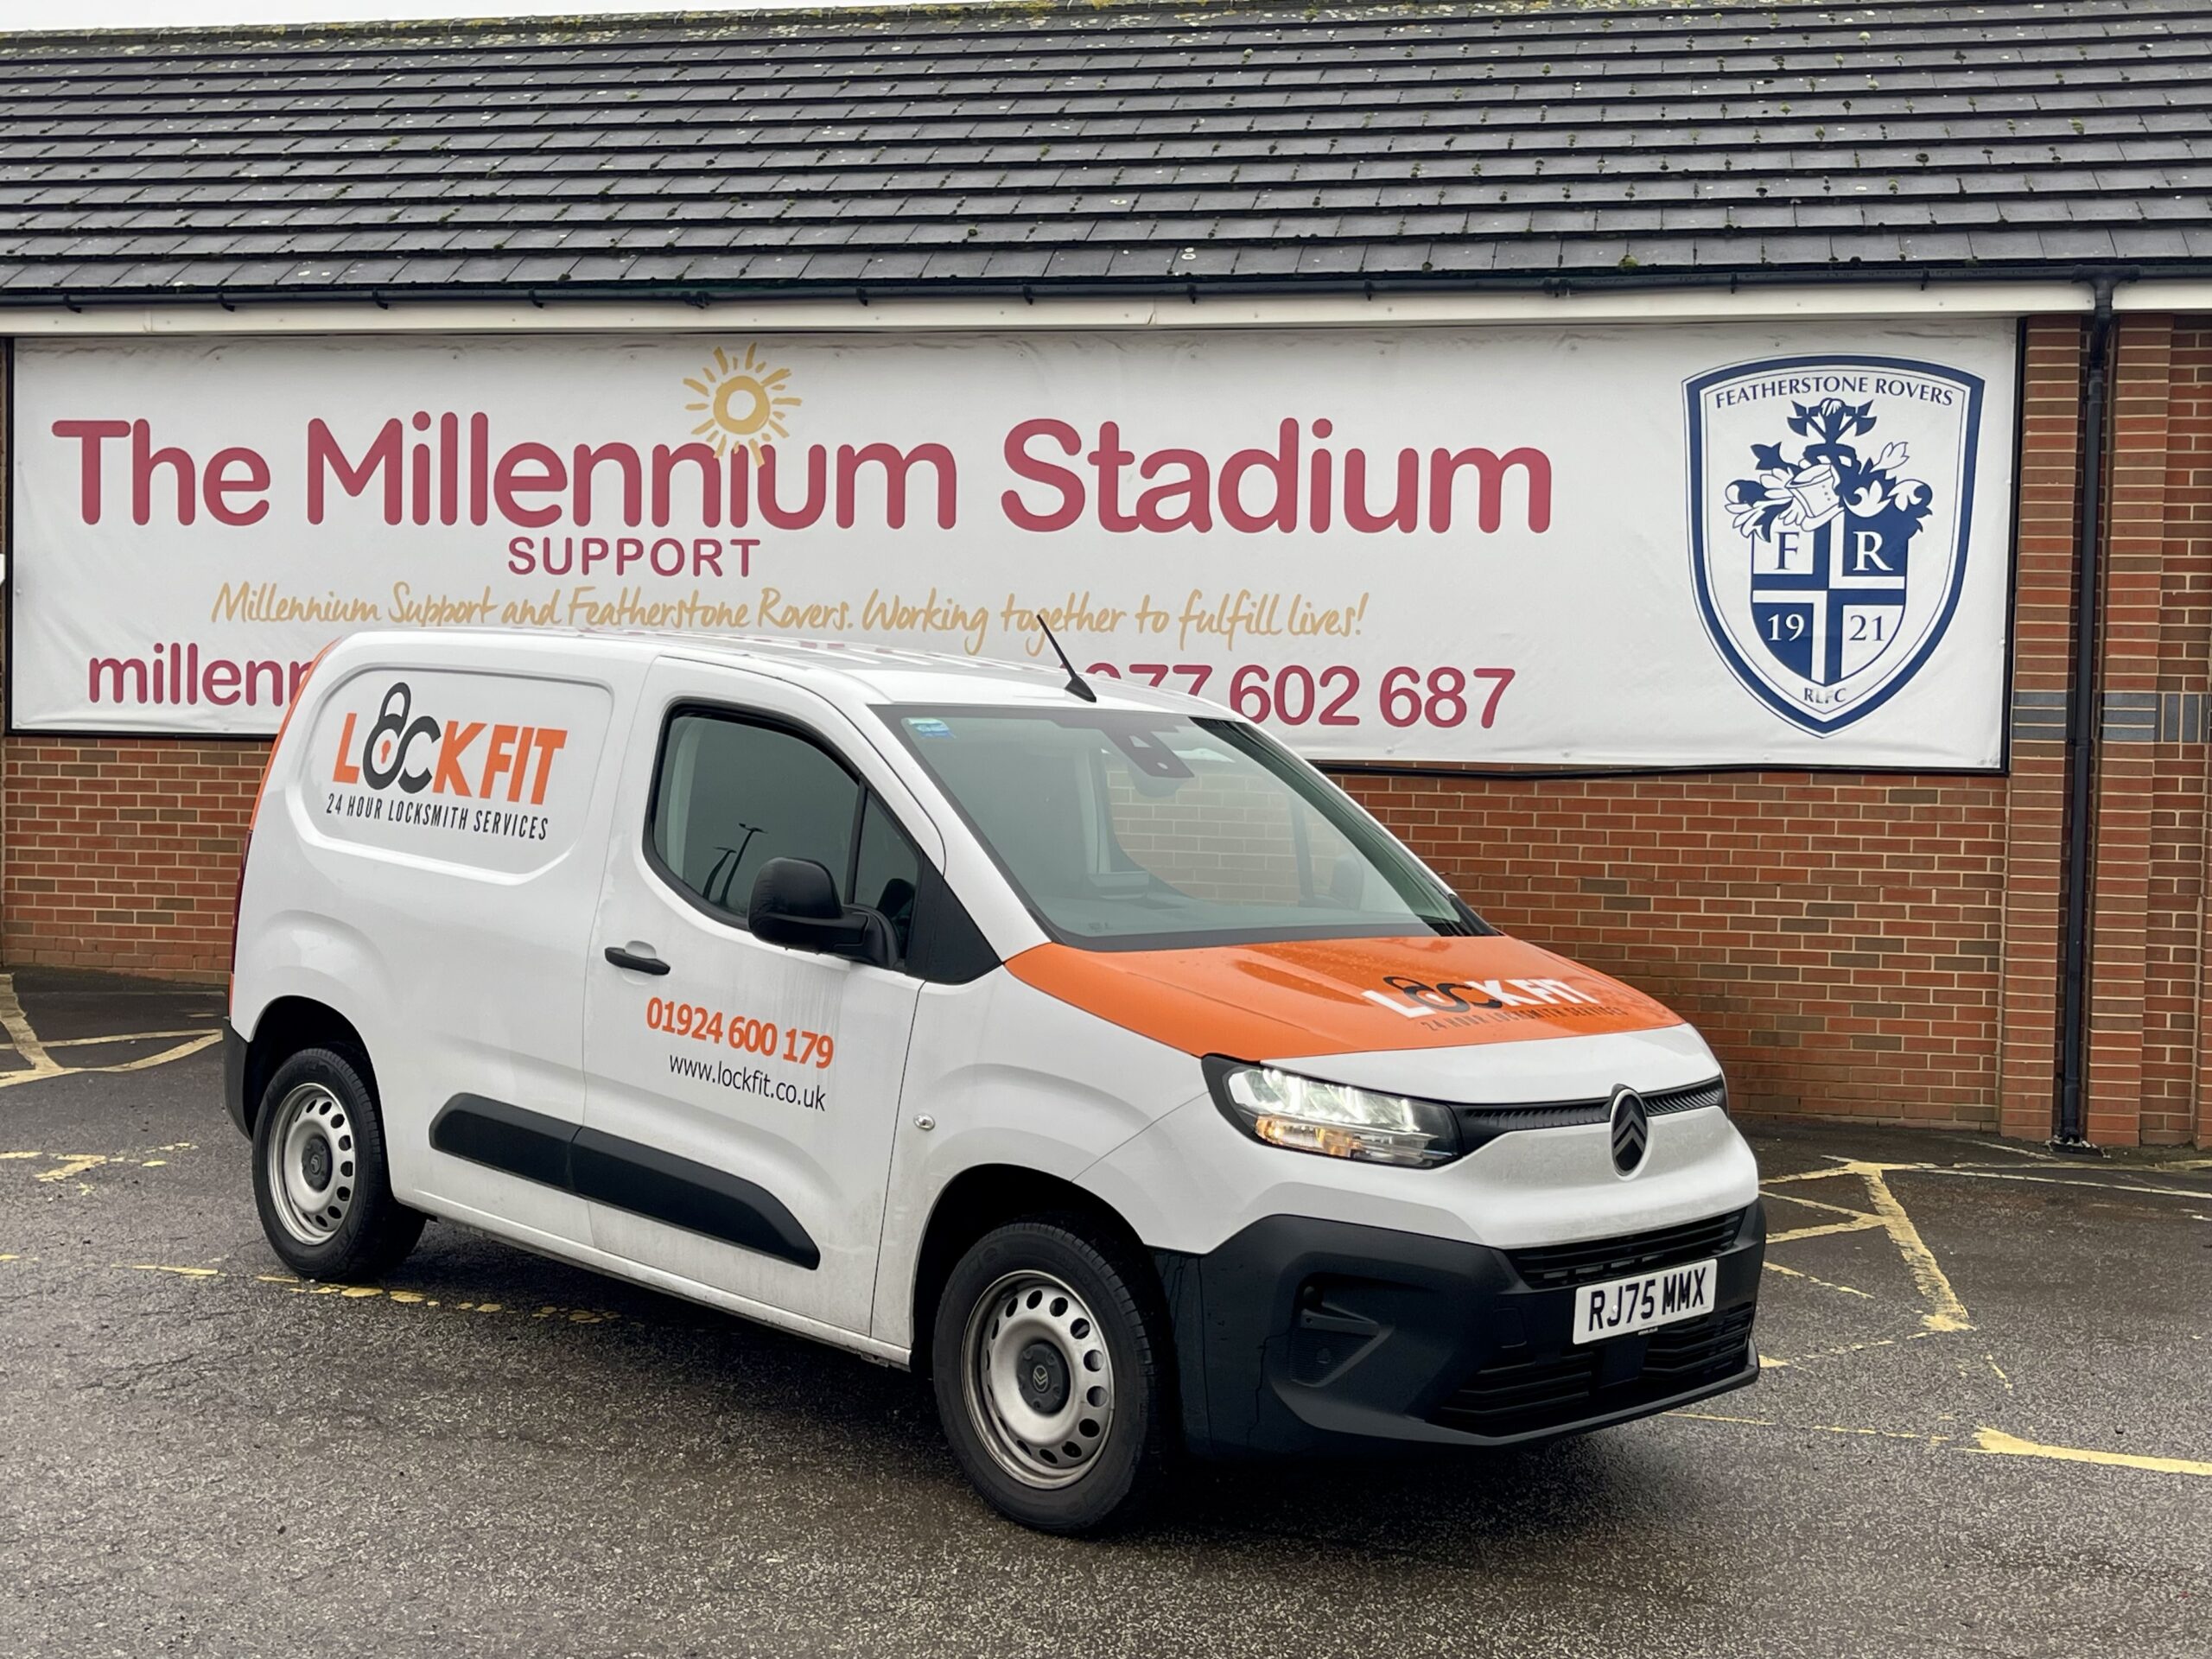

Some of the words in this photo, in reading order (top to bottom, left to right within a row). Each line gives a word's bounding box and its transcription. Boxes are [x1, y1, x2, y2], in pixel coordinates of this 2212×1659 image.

[1715, 377, 1868, 409] FEATHERSTONE
[1875, 378, 1954, 406] ROVERS
[51, 418, 270, 526] The
[307, 410, 957, 531] Millennium
[1000, 417, 1553, 534] Stadium
[508, 537, 760, 577] SUPPORT
[1775, 531, 1800, 570] F
[1853, 531, 1893, 571] R
[211, 581, 382, 623] Millennium
[388, 581, 499, 627] Support
[501, 589, 563, 626] and
[568, 585, 750, 628] Featherstone
[758, 587, 854, 631] Rovers.
[861, 587, 990, 656] Working
[1000, 591, 1127, 657] together
[1135, 594, 1170, 634] to
[1178, 588, 1285, 651] fulfill
[1287, 592, 1370, 636] lives!
[1767, 613, 1805, 642] 19
[1848, 614, 1885, 642] 21
[1229, 664, 1360, 726] 602
[1379, 666, 1516, 729] 687
[333, 682, 568, 805] LOCKFIT
[326, 793, 343, 815] 24
[346, 797, 382, 820] HOUR
[388, 799, 468, 830] LOCKSMITH
[474, 810, 548, 841] SERVICES
[646, 997, 723, 1045] 01924
[728, 1015, 778, 1057] 600
[783, 1028, 835, 1069] 179
[670, 1054, 826, 1112] www.lockfit.co.uk
[1588, 1279, 1656, 1332] RJ75
[1662, 1267, 1707, 1315] MMX
